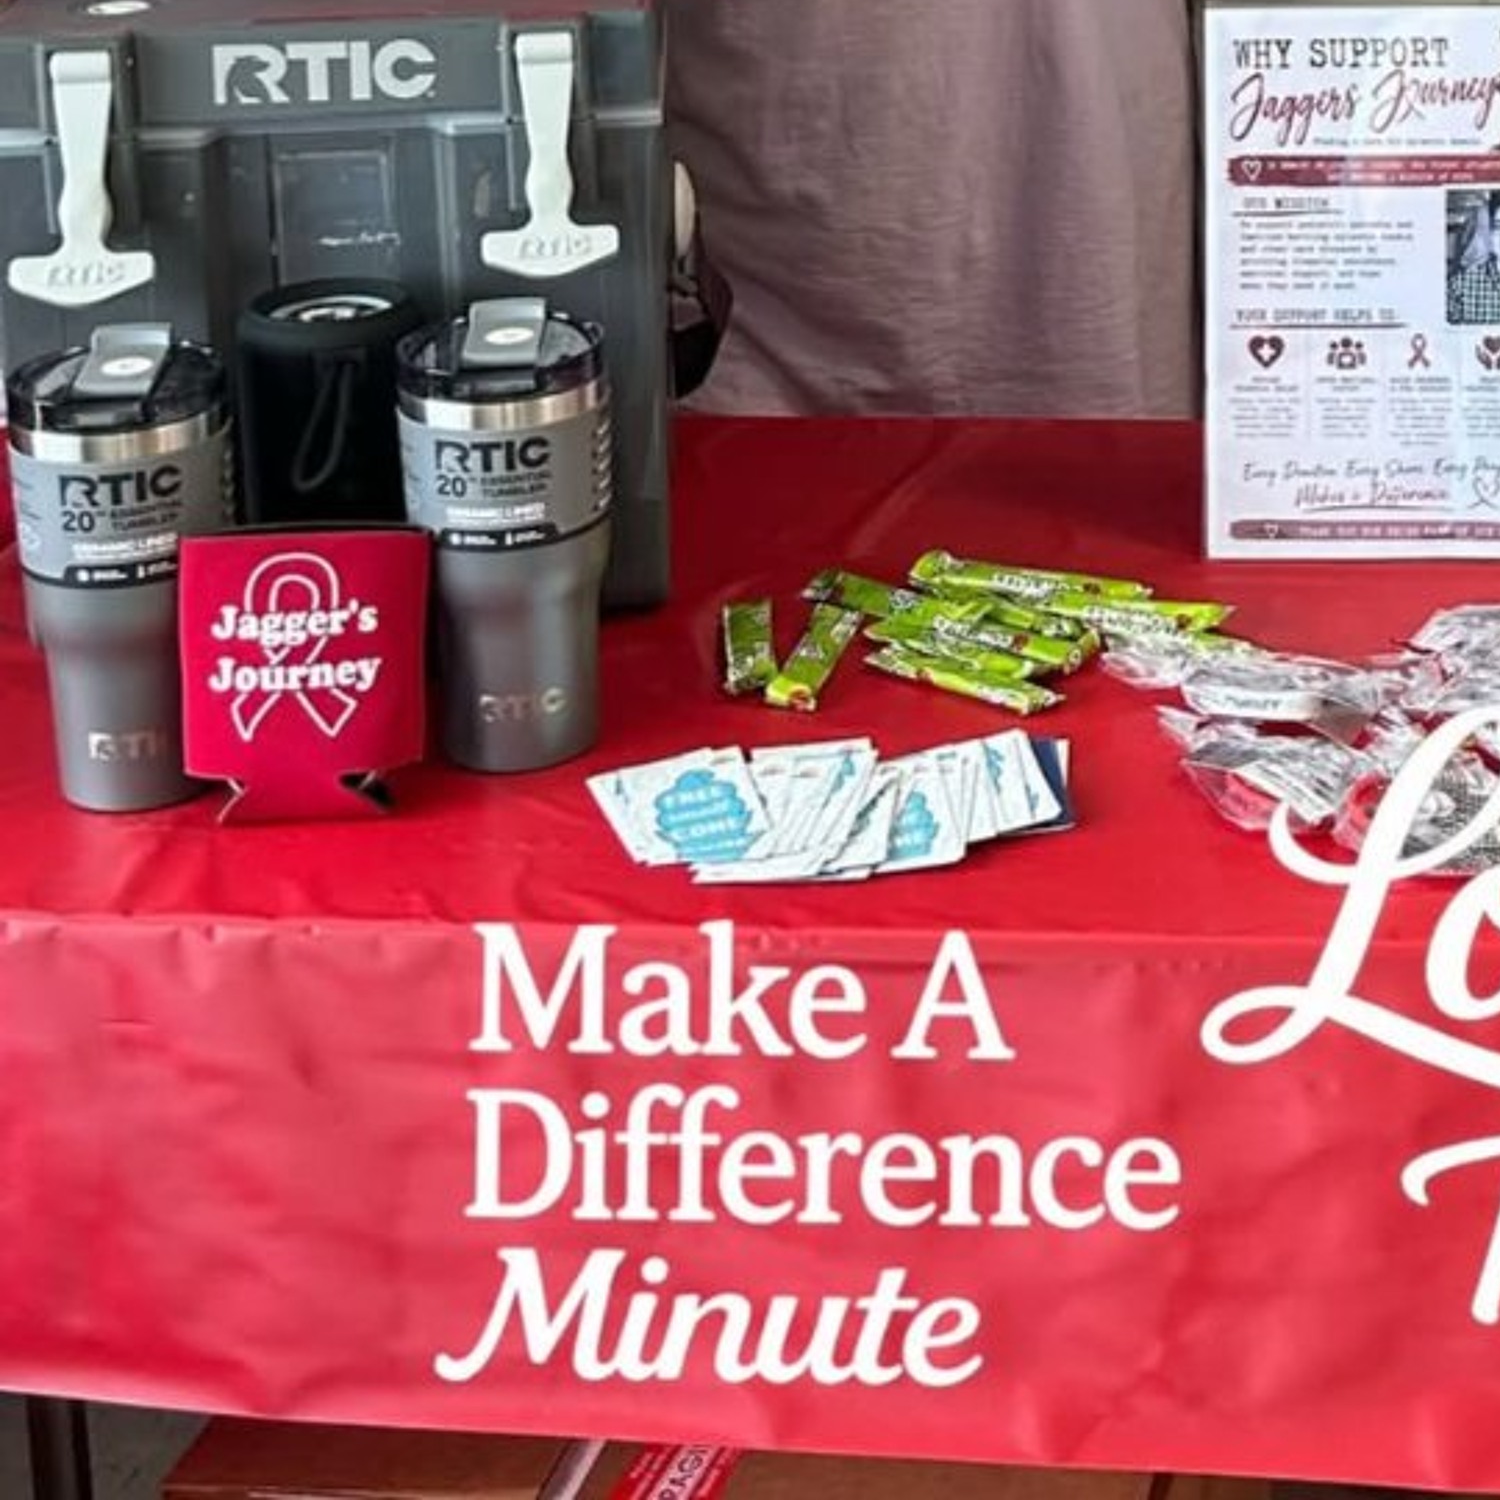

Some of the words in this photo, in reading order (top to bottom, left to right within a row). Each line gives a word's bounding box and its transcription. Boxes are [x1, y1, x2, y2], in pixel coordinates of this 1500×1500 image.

[212, 38, 437, 105] RTIC
[1233, 39, 1292, 68] WHY
[1309, 38, 1449, 67] SUPPORT
[437, 436, 550, 473] RTIC
[58, 465, 182, 507] RTIC
[210, 600, 378, 646] Jagger's
[208, 656, 382, 693] Journey
